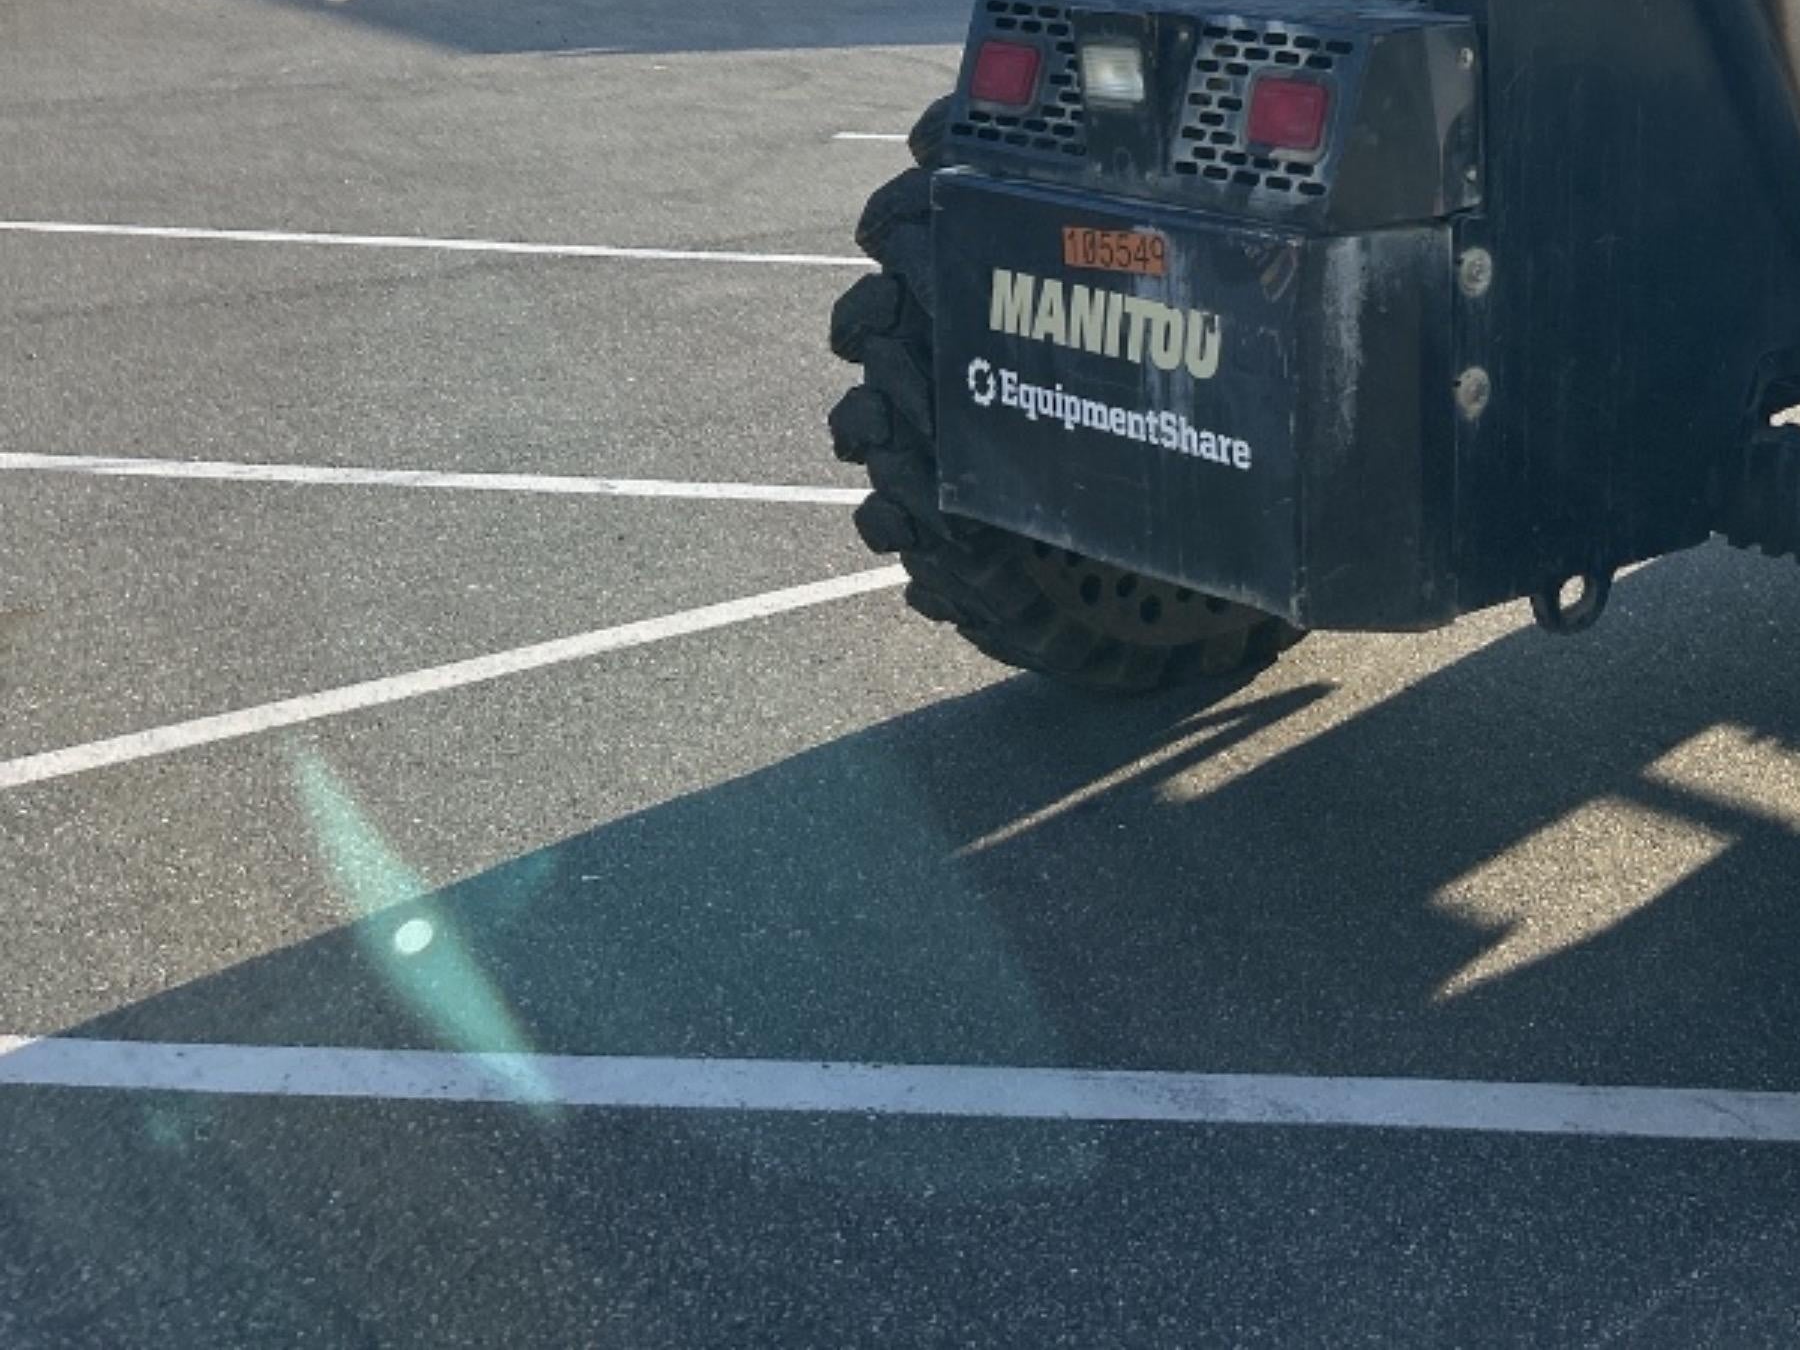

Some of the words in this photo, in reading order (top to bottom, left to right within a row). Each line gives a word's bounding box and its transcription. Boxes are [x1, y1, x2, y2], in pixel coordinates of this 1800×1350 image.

[1066, 229, 1166, 271] 105549
[989, 267, 1222, 379] MANITOU
[999, 368, 1252, 471] EquipmentShare
